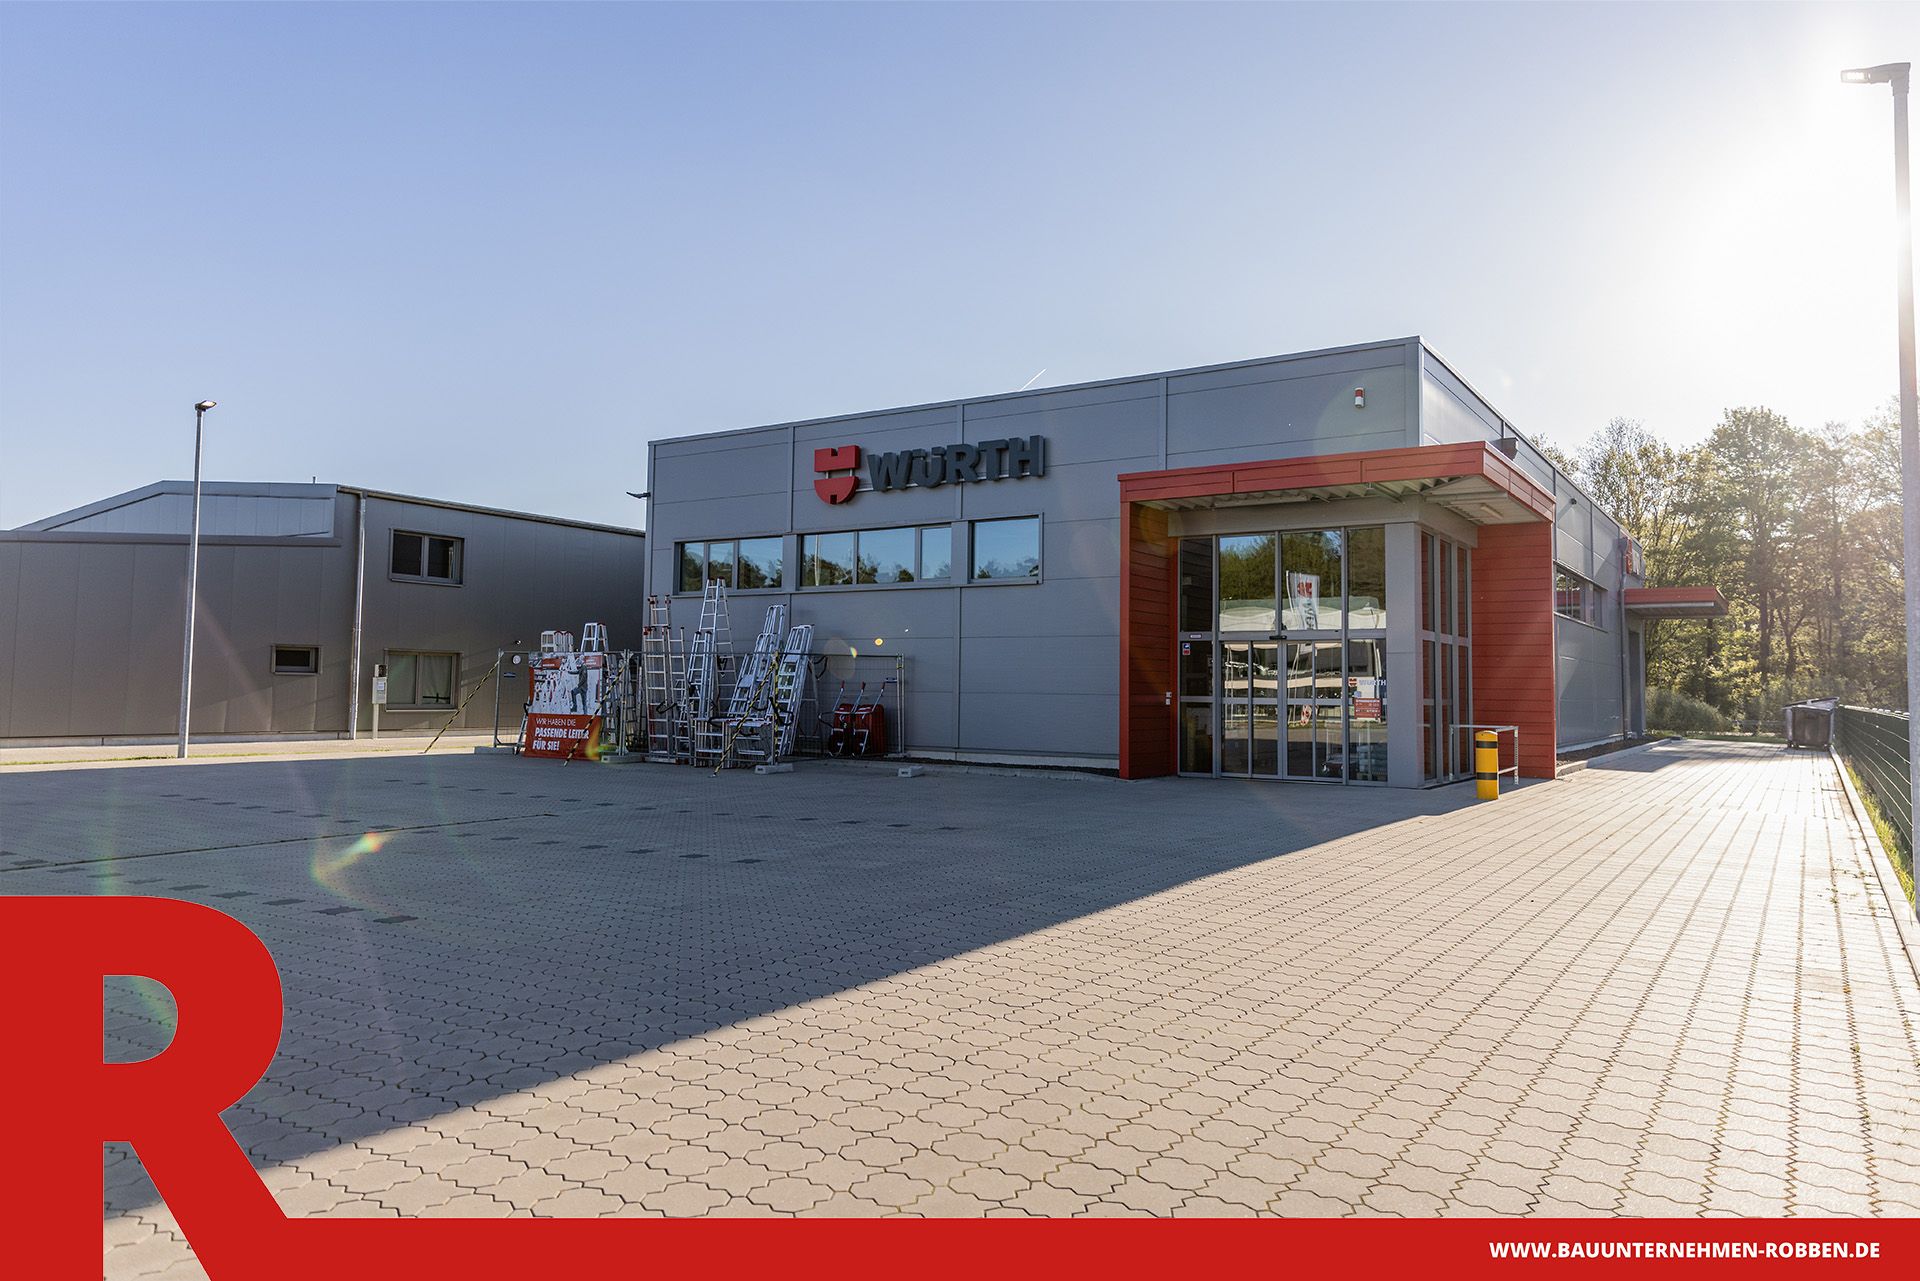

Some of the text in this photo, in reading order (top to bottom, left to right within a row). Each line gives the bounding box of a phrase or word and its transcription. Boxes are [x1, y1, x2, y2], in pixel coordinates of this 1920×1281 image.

[867, 435, 1045, 492] WÜRTH
[547, 718, 567, 726] HABEN
[535, 727, 568, 739] PASSENDE
[532, 737, 560, 751] FÜR SIE!
